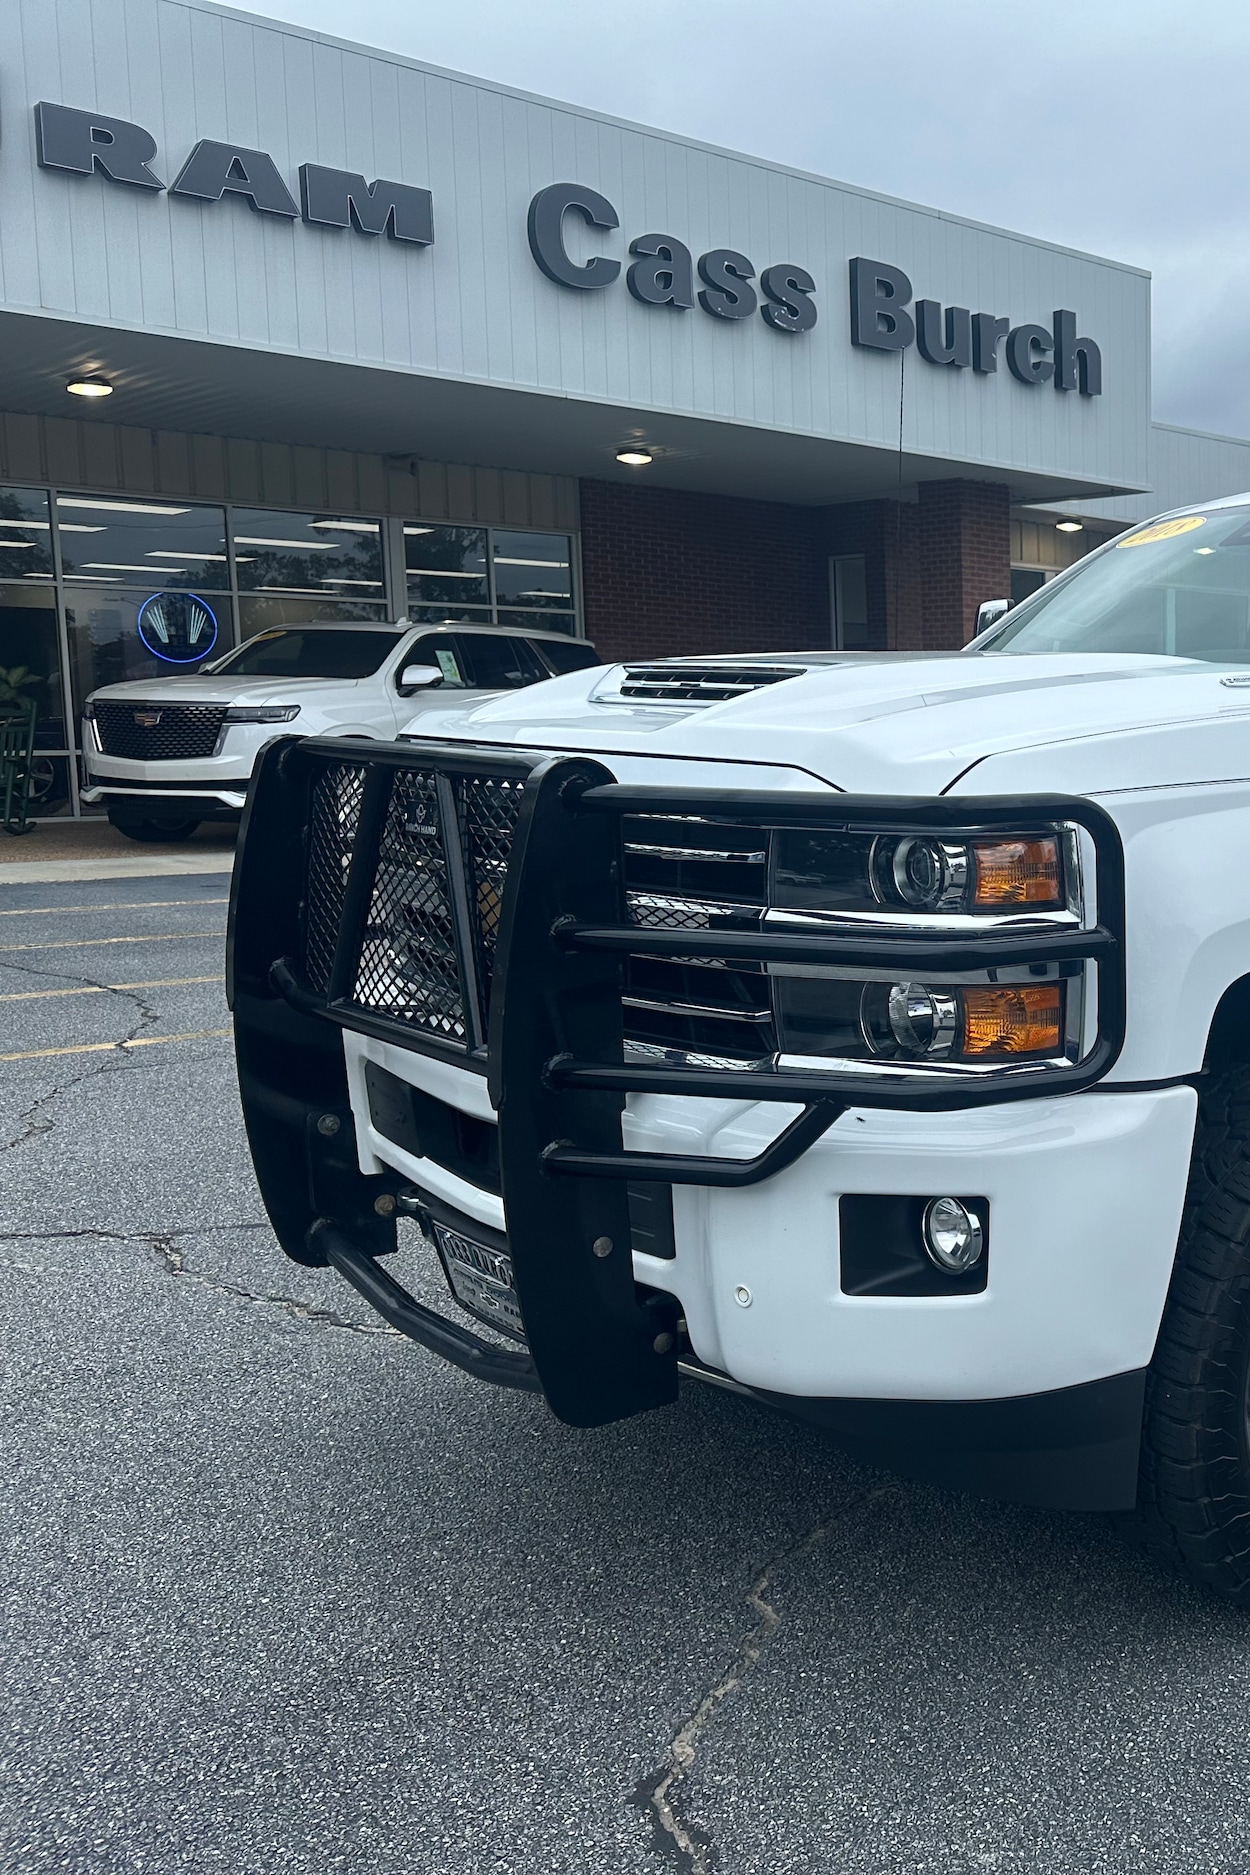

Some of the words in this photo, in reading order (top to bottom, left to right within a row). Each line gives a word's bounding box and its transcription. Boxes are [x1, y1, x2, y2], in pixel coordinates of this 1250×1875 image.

[34, 100, 434, 248] RAM
[527, 183, 817, 333] Cass
[849, 256, 1102, 396] Burch
